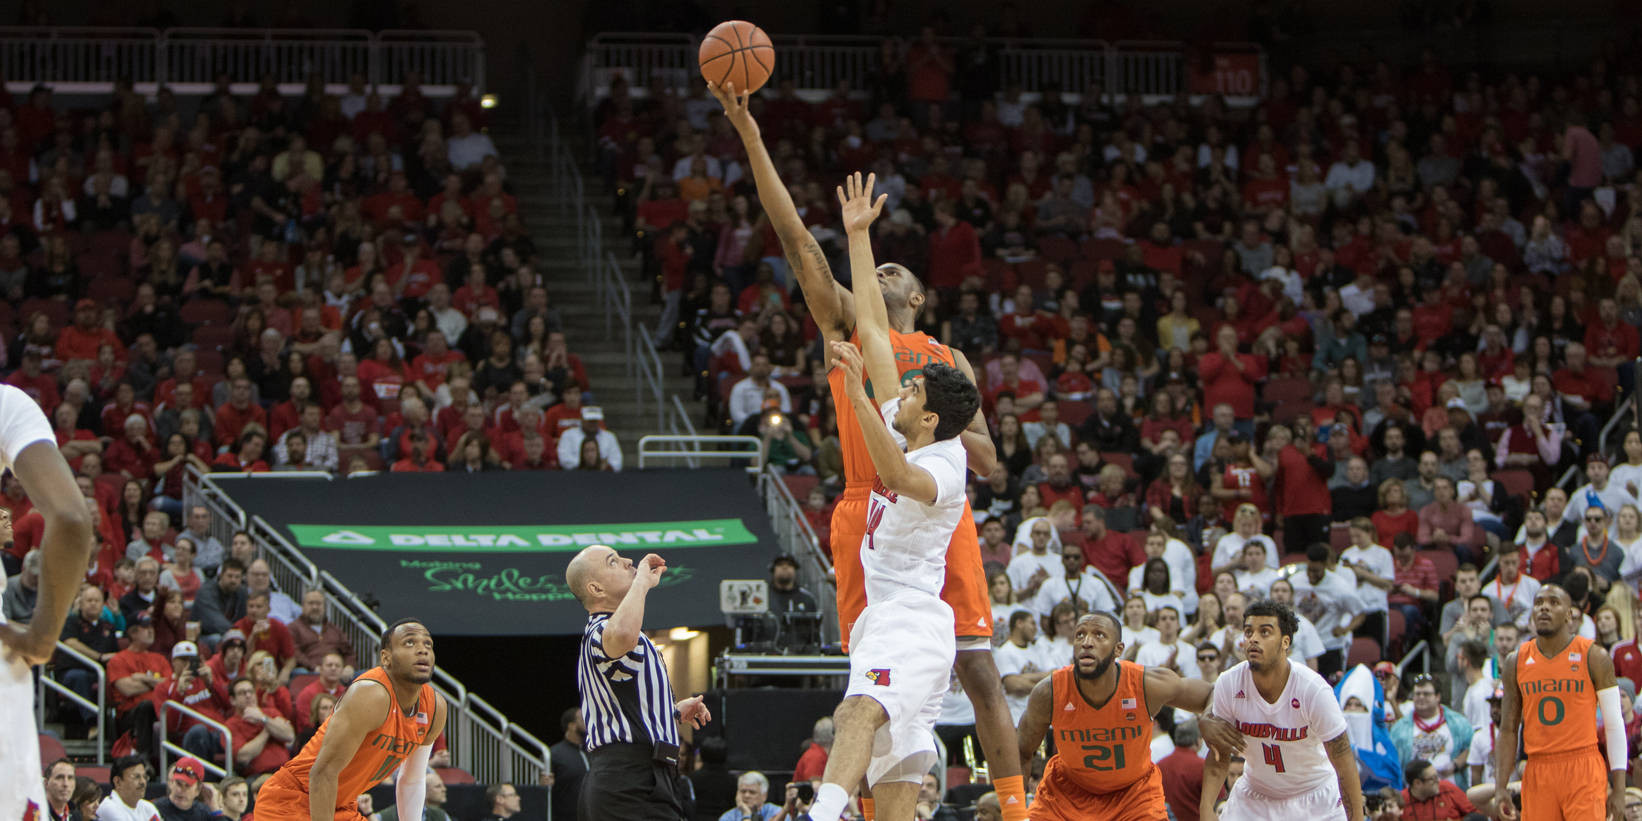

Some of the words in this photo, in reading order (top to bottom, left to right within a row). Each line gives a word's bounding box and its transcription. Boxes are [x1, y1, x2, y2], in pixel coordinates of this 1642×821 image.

[389, 534, 531, 547] DELTA
[537, 529, 723, 547] DENTAL
[400, 560, 481, 569] Making
[1538, 696, 1565, 726] 0
[1235, 720, 1309, 741] LOUISVILLE
[1081, 744, 1126, 771] 21
[1262, 742, 1286, 773] 4
